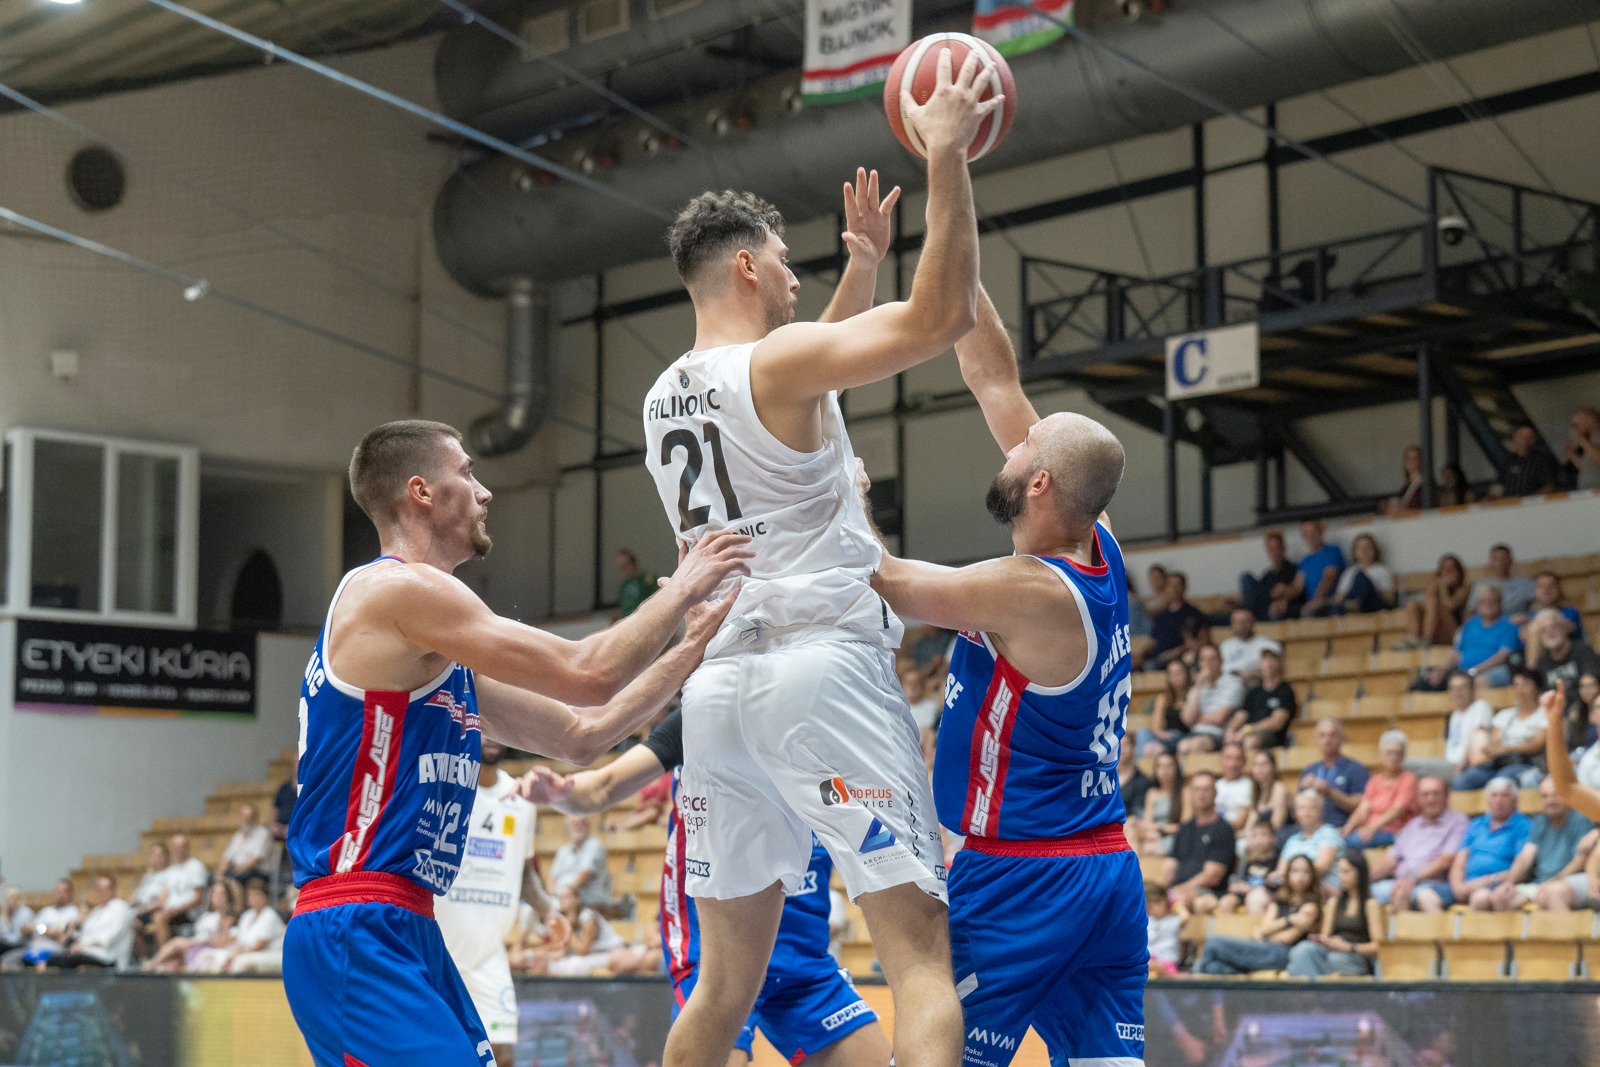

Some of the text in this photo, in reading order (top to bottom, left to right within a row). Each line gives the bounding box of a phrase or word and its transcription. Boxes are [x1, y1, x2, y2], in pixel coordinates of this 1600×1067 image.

[1173, 339, 1208, 388] C
[661, 421, 743, 532] 21
[733, 522, 767, 538] NIC
[21, 638, 251, 681] ETYEKI KÚRIA
[945, 673, 964, 709] SE
[988, 676, 1013, 741] ASE
[369, 704, 394, 787] ASE
[979, 729, 1000, 798] ASE
[862, 800, 893, 808] VICE
[865, 788, 892, 799] PLUS
[481, 812, 494, 833] 4
[964, 1045, 984, 1056] Paksi
[967, 1026, 1015, 1051] MVM
